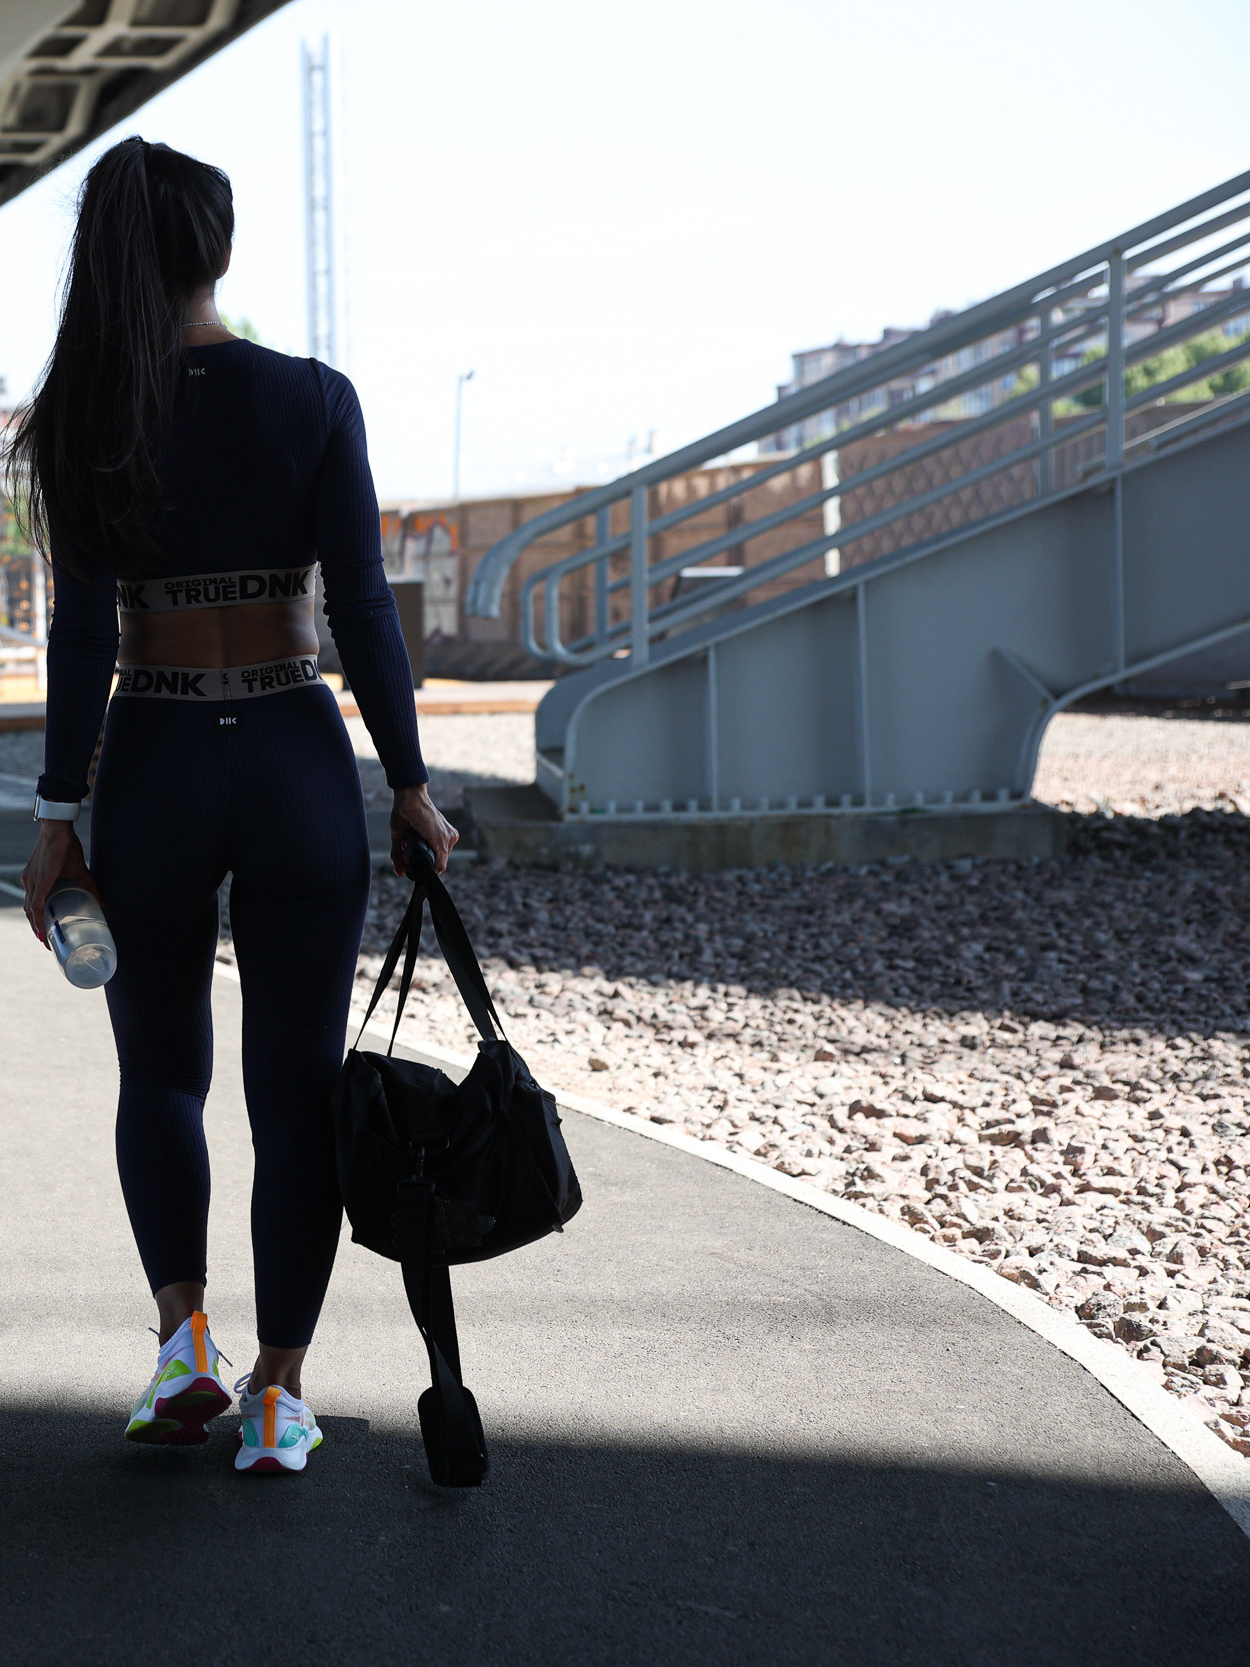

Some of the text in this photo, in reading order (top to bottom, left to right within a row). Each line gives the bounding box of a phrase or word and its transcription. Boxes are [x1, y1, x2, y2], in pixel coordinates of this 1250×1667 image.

[165, 576, 236, 590] ORIGINAL
[239, 570, 311, 600] DNK
[241, 661, 299, 679] ORIGINAL
[132, 669, 207, 697] DNK
